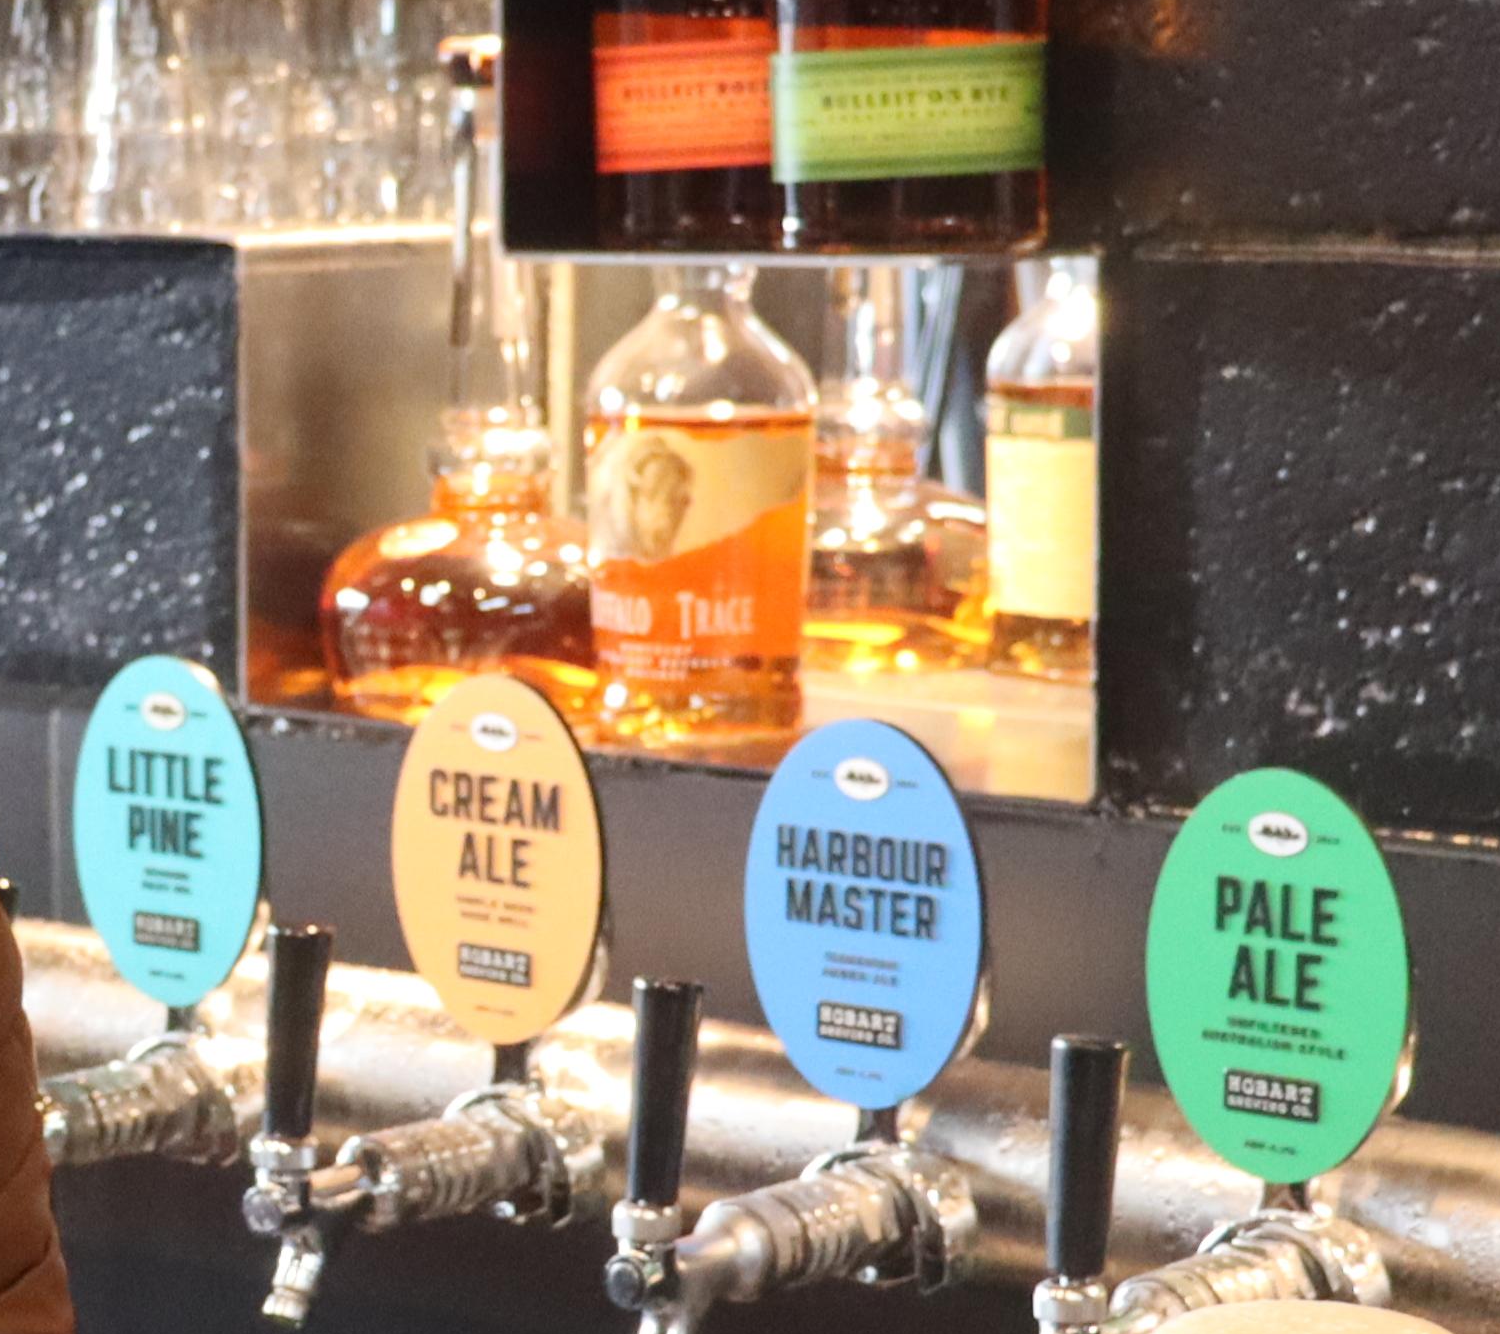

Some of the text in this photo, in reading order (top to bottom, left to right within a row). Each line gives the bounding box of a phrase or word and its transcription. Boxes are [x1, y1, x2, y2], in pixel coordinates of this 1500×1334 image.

[107, 746, 226, 805] LITTLE
[428, 768, 562, 833] CREAM
[127, 804, 205, 860] PINE
[457, 832, 533, 890] ALE
[775, 823, 951, 888] HARBOUR
[785, 877, 942, 941] MASTER
[1214, 874, 1342, 948] PALE
[1227, 943, 1326, 1013] ALE
[819, 1004, 898, 1035] HOBART
[1227, 1074, 1314, 1105] HOBART
